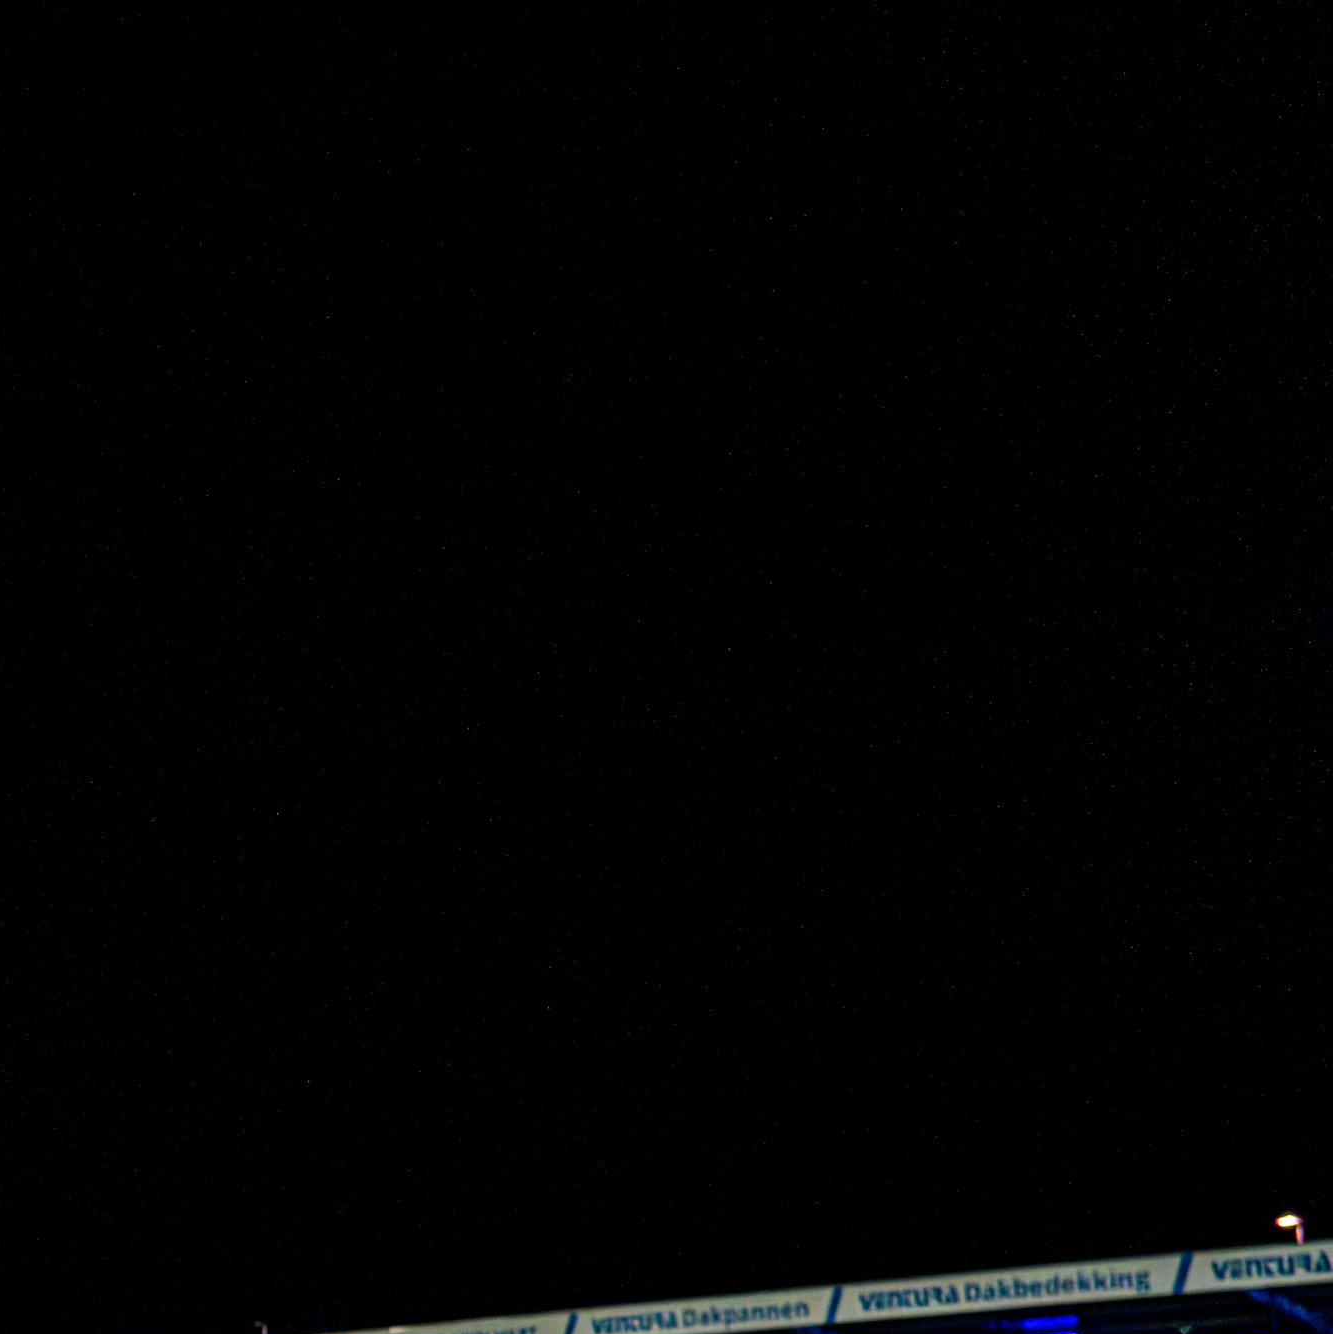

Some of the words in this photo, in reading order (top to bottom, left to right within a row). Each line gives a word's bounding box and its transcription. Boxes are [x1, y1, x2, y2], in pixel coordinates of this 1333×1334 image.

[858, 1285, 959, 1312] VENTURA
[963, 1268, 1150, 1304] Dakbedekking
[682, 1302, 811, 1331] Dakpannen
